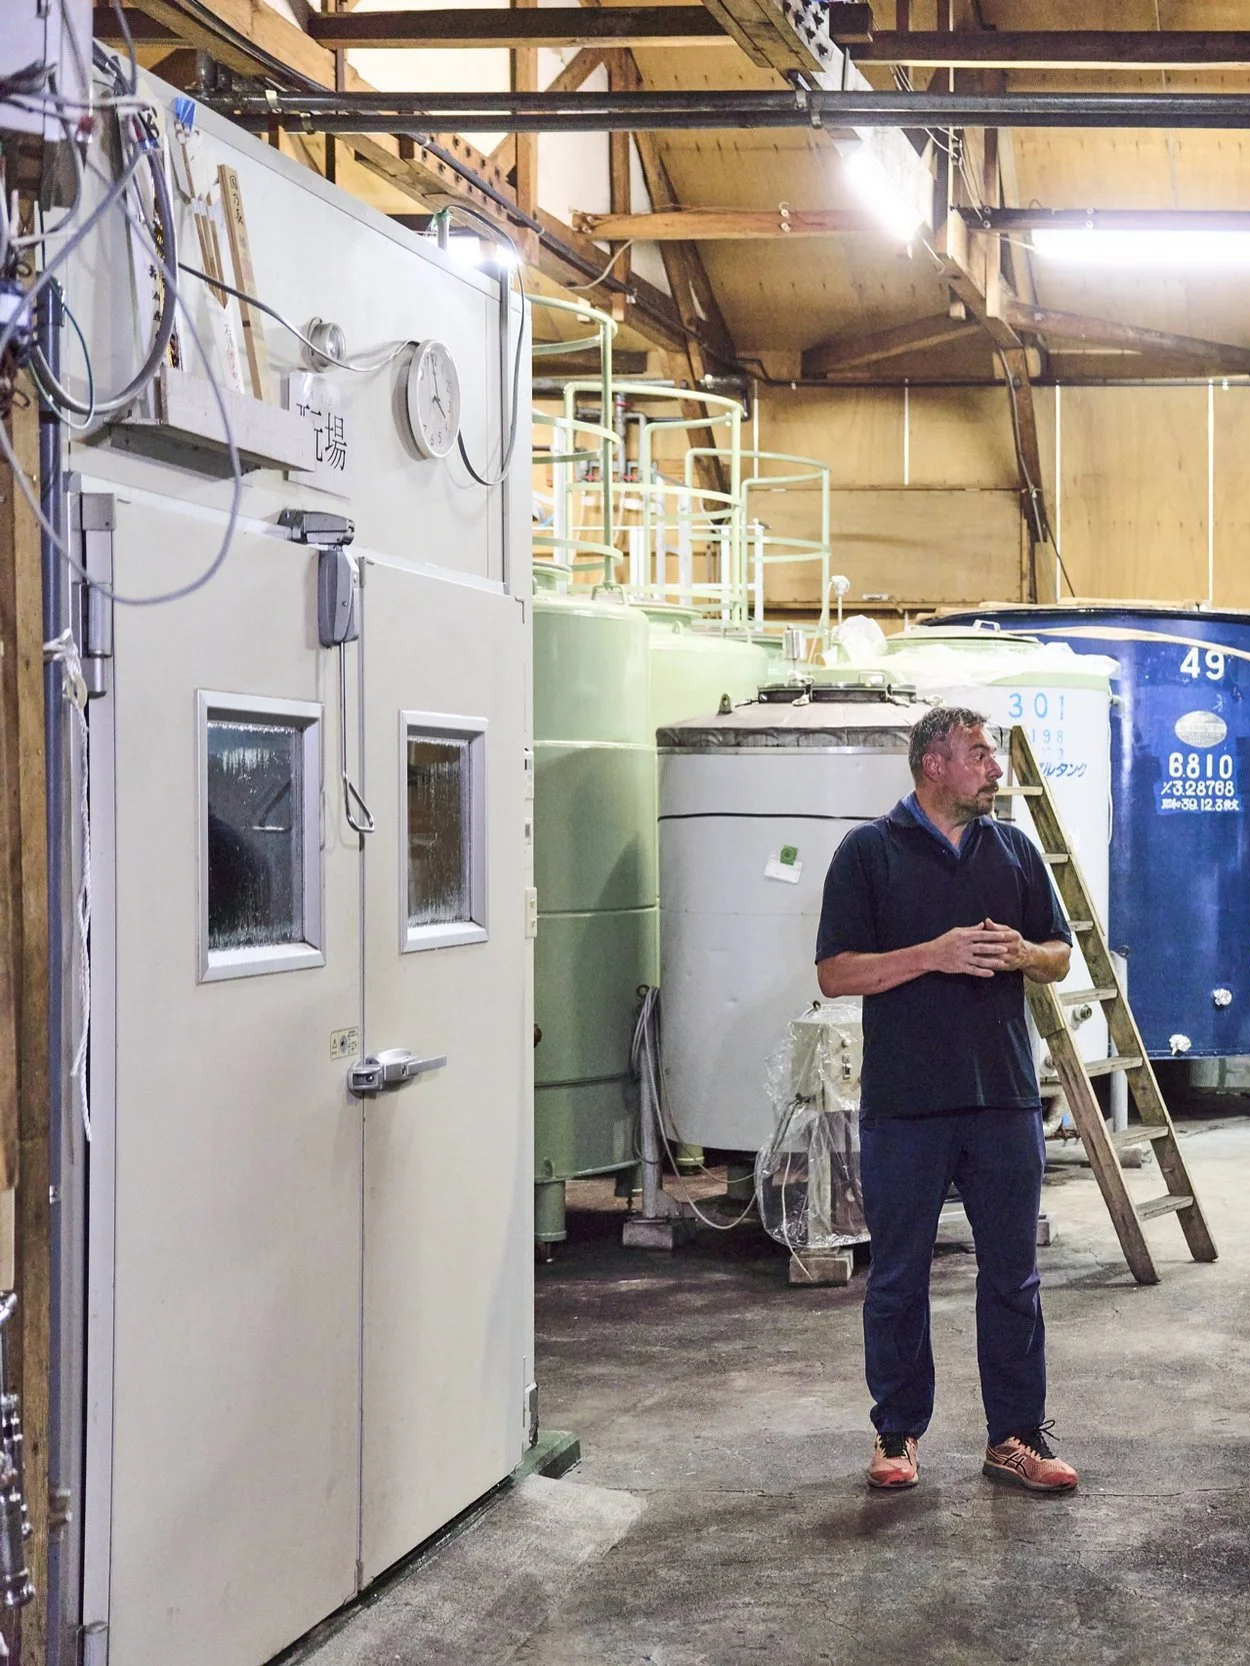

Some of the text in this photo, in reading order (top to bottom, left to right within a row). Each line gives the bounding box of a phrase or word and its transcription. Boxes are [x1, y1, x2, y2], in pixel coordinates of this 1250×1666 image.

[1180, 647, 1225, 680] 49
[1039, 762, 1087, 777] ルタンク
